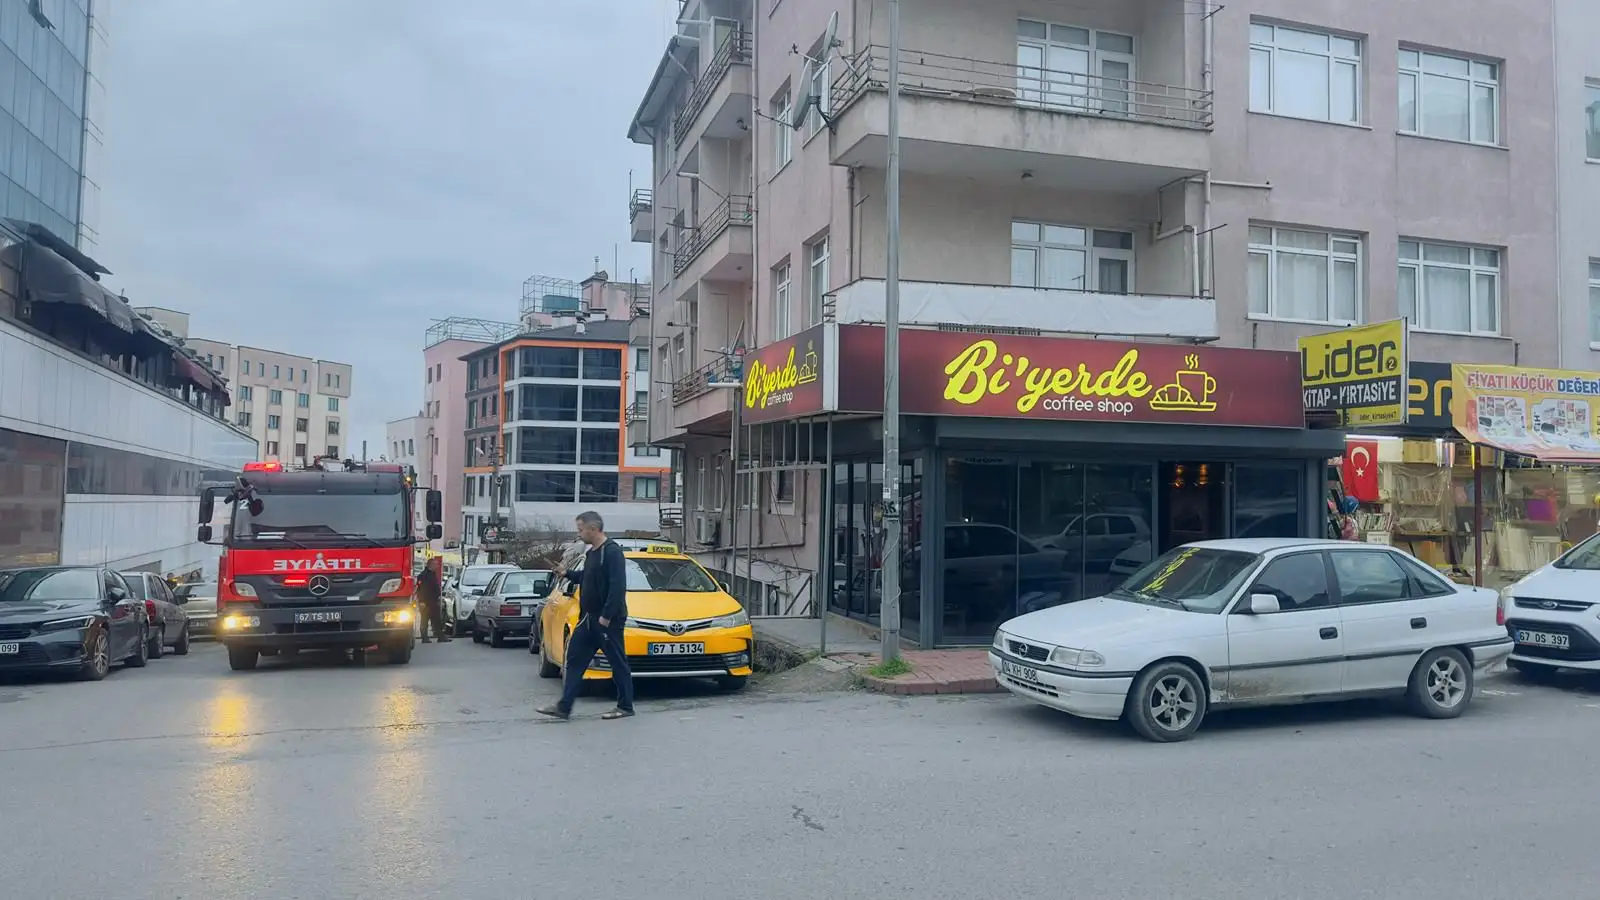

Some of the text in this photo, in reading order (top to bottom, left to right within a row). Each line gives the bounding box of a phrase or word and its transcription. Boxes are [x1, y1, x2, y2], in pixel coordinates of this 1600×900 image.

[1302, 340, 1396, 381] Lider
[746, 347, 798, 409] Bi'yerde
[944, 339, 1152, 413] Bi'yerde
[1467, 371, 1600, 396] FİYATI KÜÇÜK DEĞER
[782, 391, 793, 404] shop
[1043, 396, 1133, 416] coffee shop
[300, 613, 309, 621] 67
[326, 612, 340, 620] 110
[1520, 631, 1530, 641] 67
[1551, 635, 1568, 645] 397
[1, 644, 17, 653] 099
[653, 644, 703, 653] 67 T 5134
